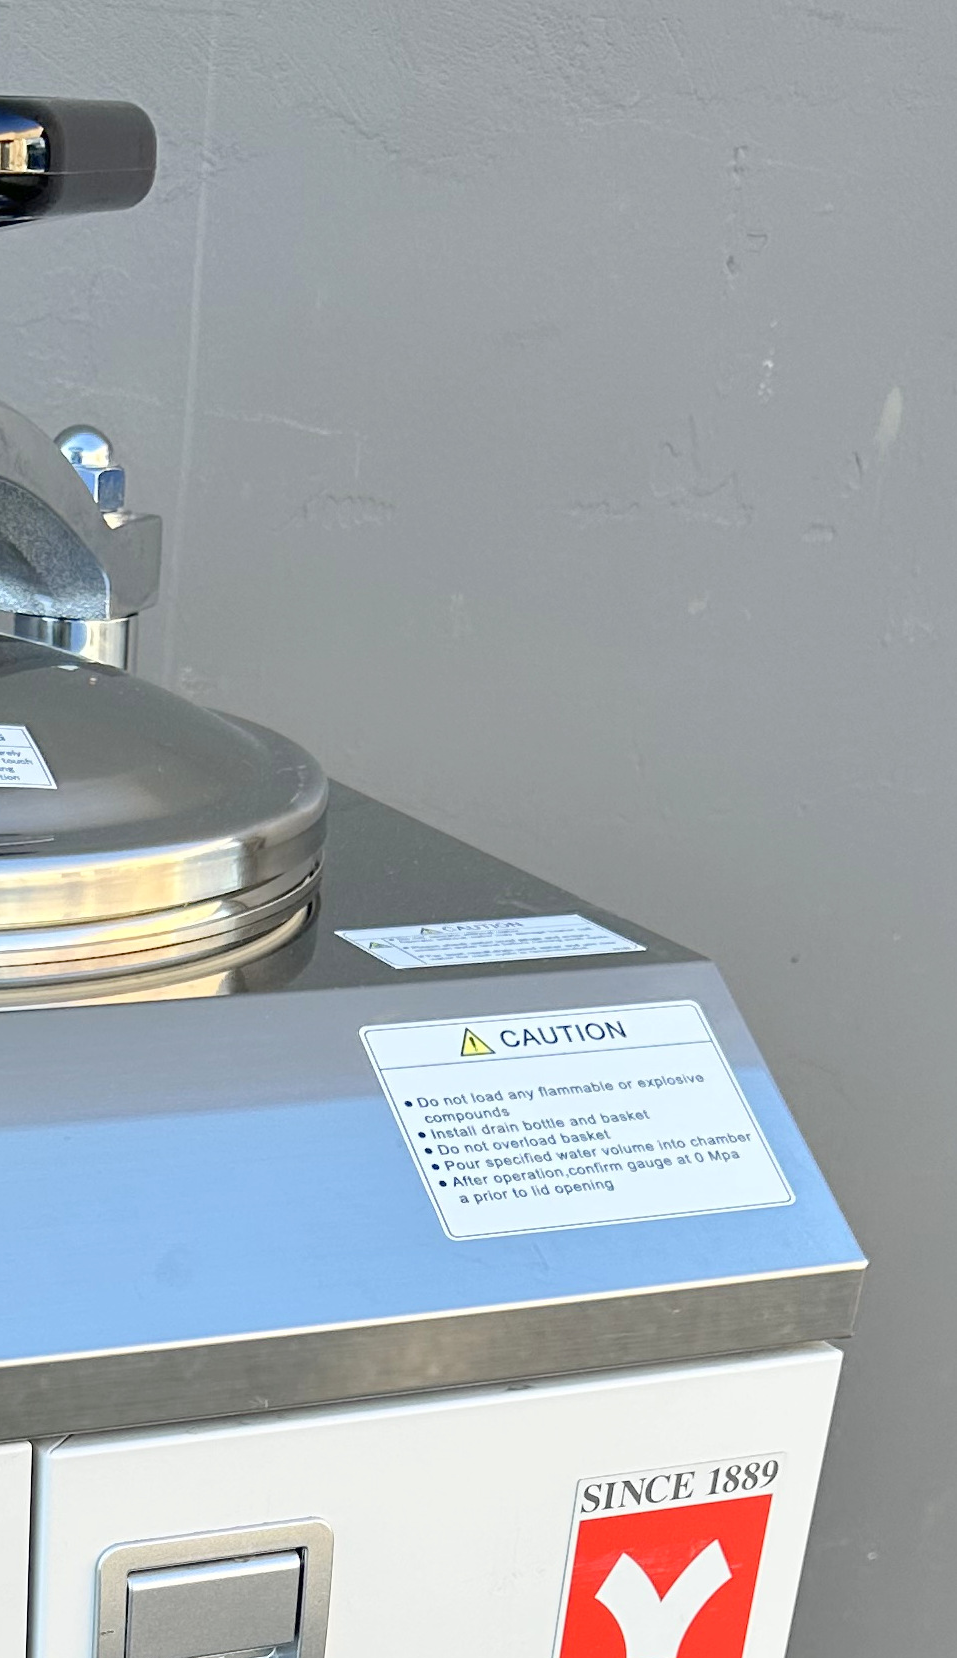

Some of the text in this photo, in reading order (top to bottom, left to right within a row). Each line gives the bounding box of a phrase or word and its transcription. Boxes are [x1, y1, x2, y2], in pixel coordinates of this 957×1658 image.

[442, 921, 524, 932] CAUTION
[500, 1021, 627, 1047] CAUTION
[417, 1073, 704, 1108] Do not load any flammable or explosive
[424, 1106, 510, 1124] compounds
[430, 1109, 651, 1140] Install drain bottle and basket
[437, 1129, 612, 1156] Do not overload basket
[444, 1132, 752, 1172] Pour specified water volume into chamber
[453, 1175, 489, 1188] After
[627, 1157, 673, 1173] gauge
[676, 1155, 692, 1166] at
[694, 1152, 704, 1163] 0
[707, 1150, 741, 1163] Mpa
[459, 1180, 615, 1205] a prior to lid opening
[580, 1459, 780, 1513] SINCE 1889
